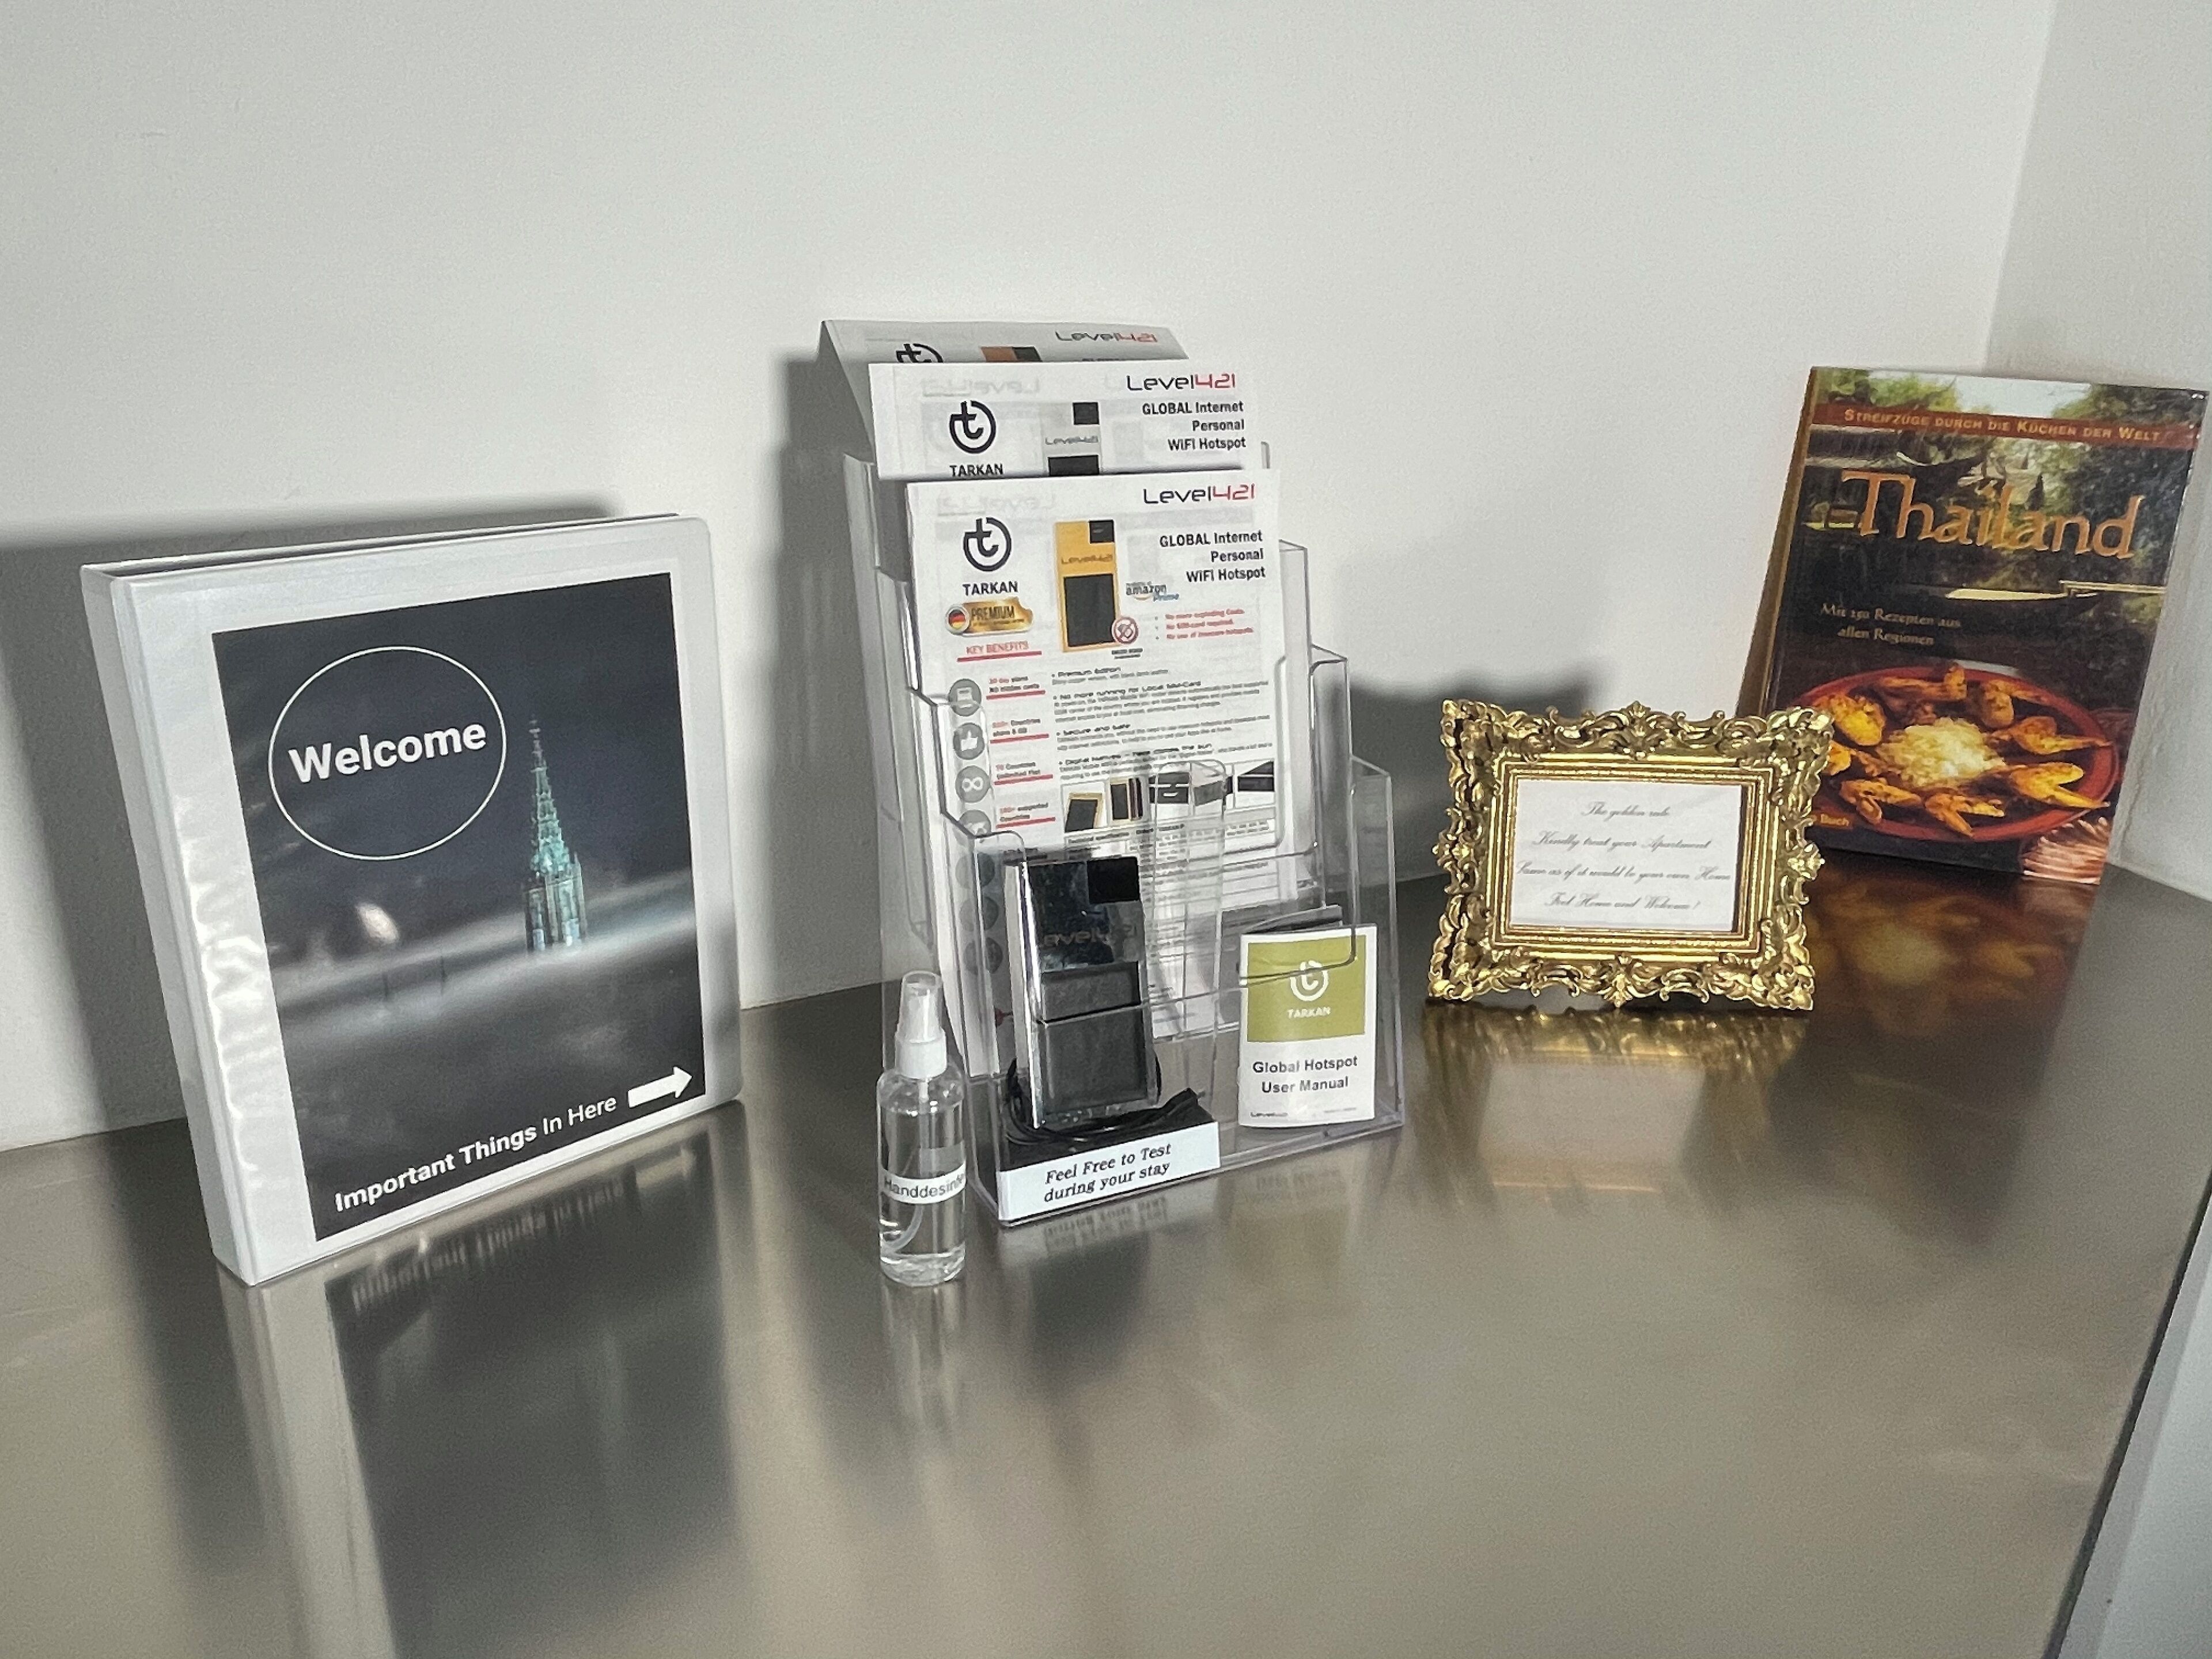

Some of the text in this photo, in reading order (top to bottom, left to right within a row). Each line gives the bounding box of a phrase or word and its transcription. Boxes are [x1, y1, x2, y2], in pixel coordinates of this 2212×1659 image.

[1055, 331, 1158, 343] Level421
[1126, 373, 1236, 391] Level421
[1142, 401, 1244, 415] GLOBAL Internet
[1192, 419, 1244, 431] Personal
[1199, 437, 1247, 452] Hotspot
[949, 463, 1004, 477] TARKAN
[1142, 483, 1256, 505] Level421
[1842, 469, 2144, 560] Thailand
[1159, 529, 1263, 548] GLOBAL Internet
[1210, 548, 1264, 563] Personal
[1217, 566, 1266, 582] Hotspot
[962, 581, 1018, 597] TARKAN
[1126, 584, 1167, 596] amazon
[971, 605, 1015, 621] PREMIUM
[1874, 608, 1935, 626] Rezepten
[1873, 627, 1936, 646] Regionen
[966, 641, 1029, 654] KEY BENEFITS
[287, 722, 487, 783] Welcome
[1287, 1006, 1332, 1018] TARKAN
[1252, 1055, 1358, 1074] Global Hotspot
[1262, 1075, 1349, 1093] User Manual
[334, 1097, 617, 1213] Important Things In Here
[1044, 1143, 1172, 1185] Feel Free to Test
[1043, 1162, 1171, 1203] during your stay
